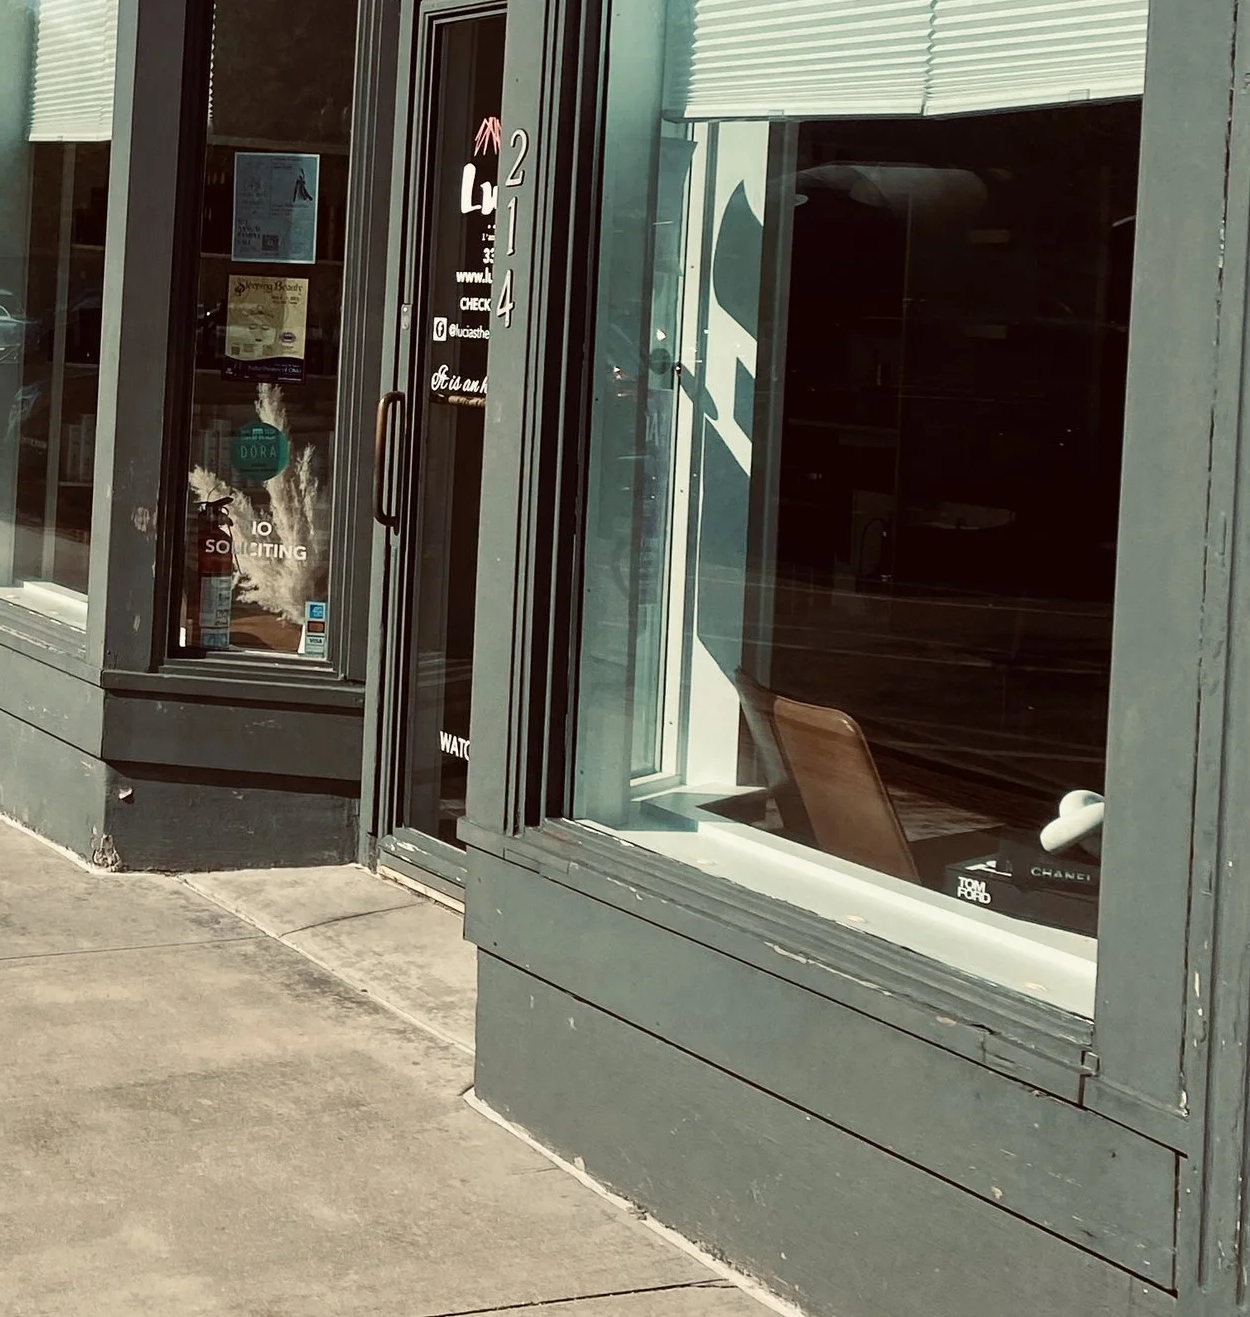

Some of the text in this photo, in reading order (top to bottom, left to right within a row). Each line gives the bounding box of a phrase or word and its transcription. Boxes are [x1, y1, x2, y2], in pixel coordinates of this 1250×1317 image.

[234, 278, 303, 296] Sleeping Beauty
[460, 297, 491, 312] CHECK
[449, 374, 462, 391] is
[240, 444, 278, 459] DORA
[957, 876, 987, 893] TOM
[957, 886, 991, 904] FORD
